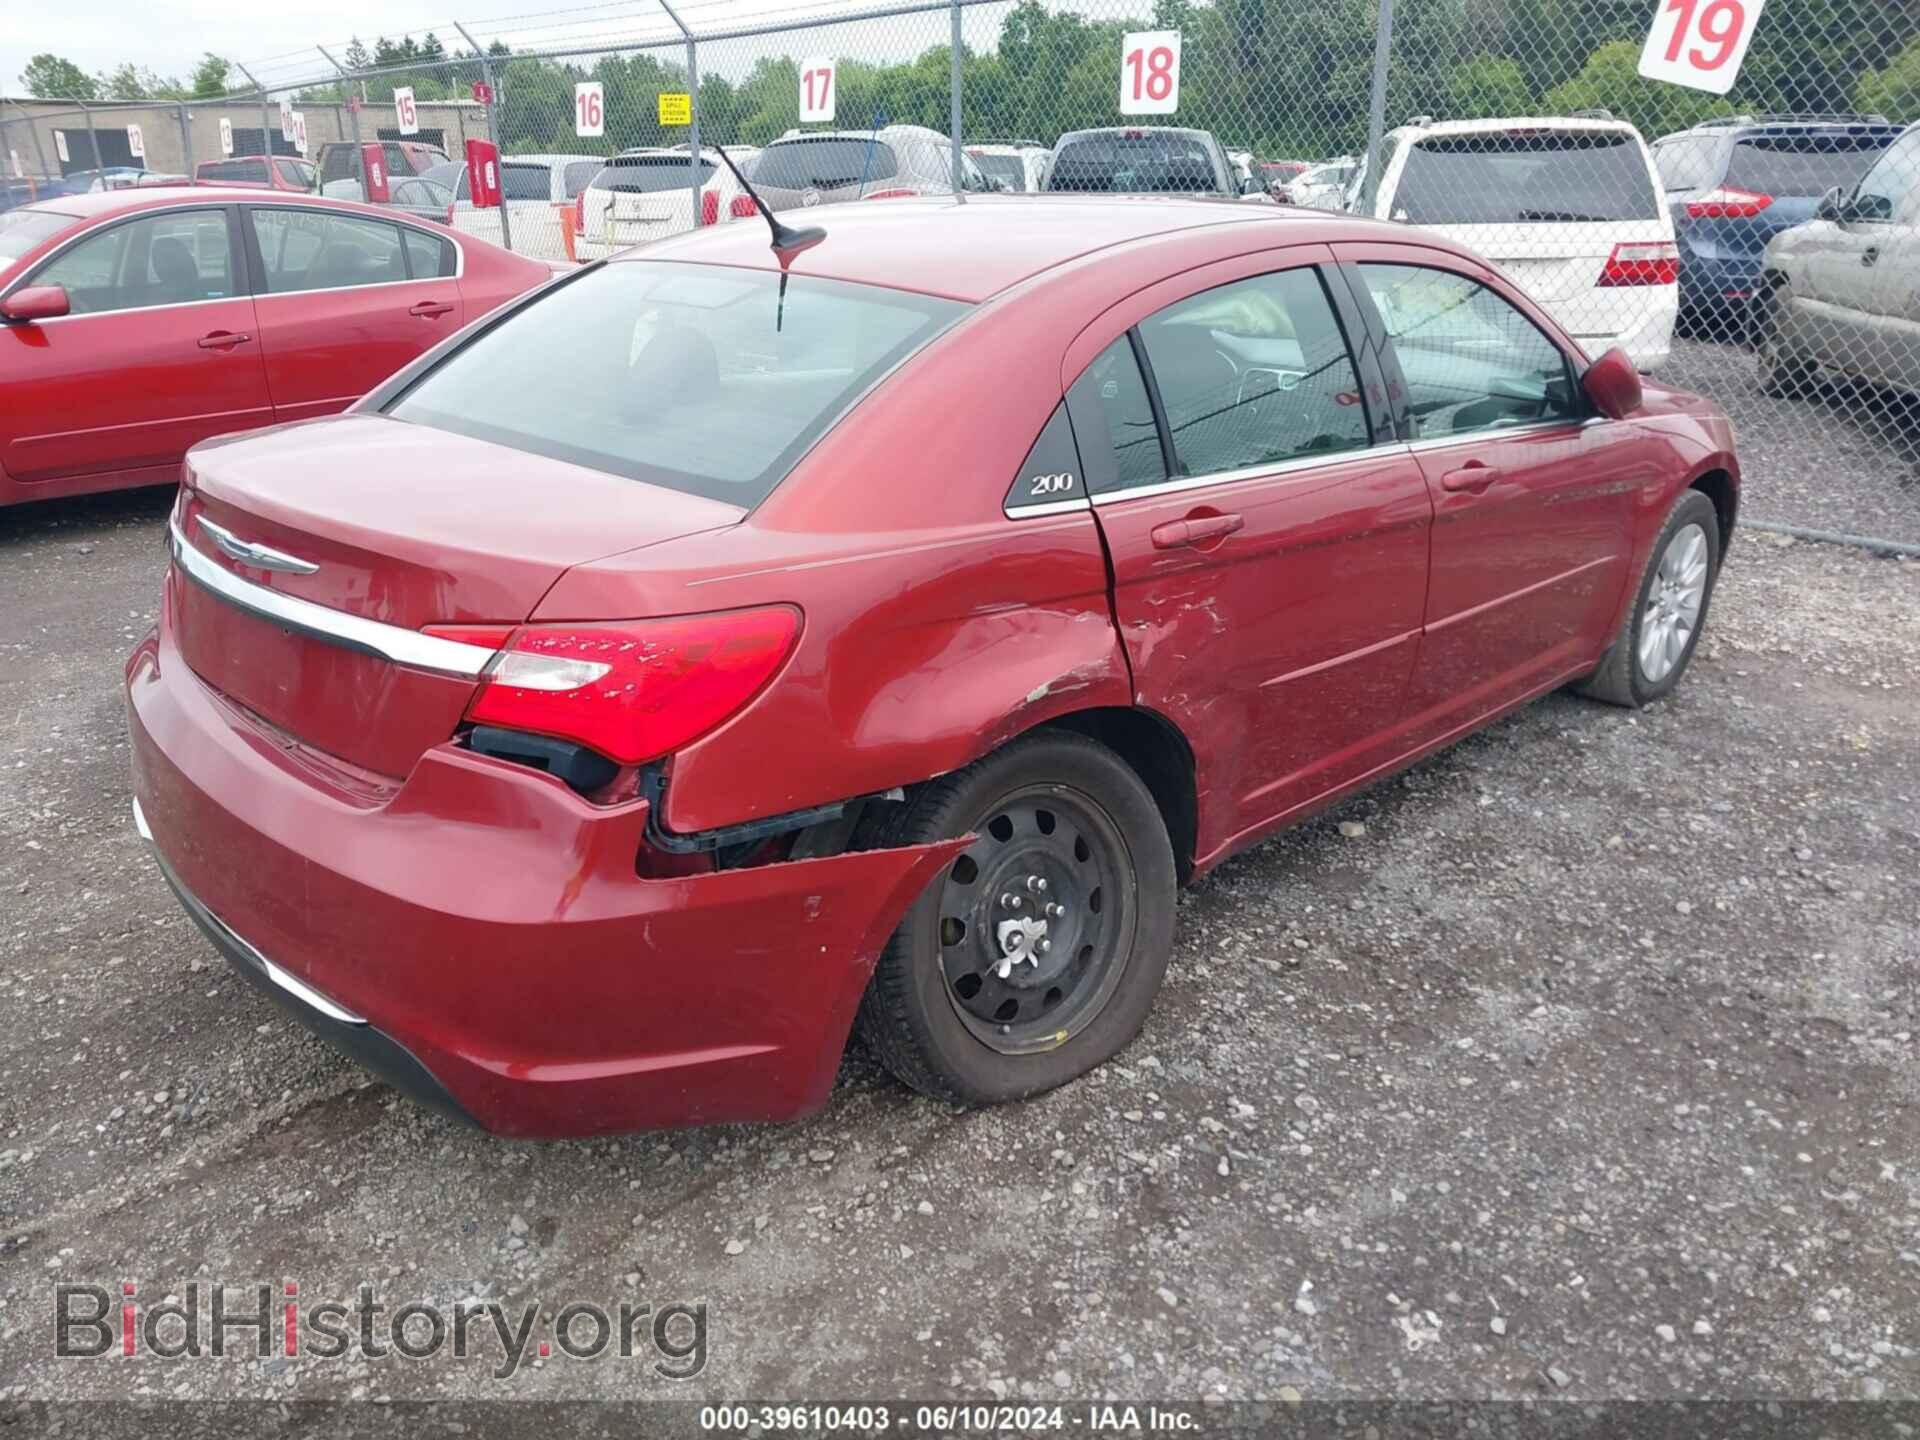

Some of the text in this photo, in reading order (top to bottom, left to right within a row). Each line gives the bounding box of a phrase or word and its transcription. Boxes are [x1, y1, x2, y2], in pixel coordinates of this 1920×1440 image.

[1664, 0, 1745, 71] 19
[802, 68, 832, 111] 17
[1126, 46, 1174, 101] 18
[397, 97, 415, 126] 15
[578, 91, 601, 128] 16
[129, 129, 143, 151] 12
[293, 120, 306, 146] 14
[1031, 472, 1073, 496] 200
